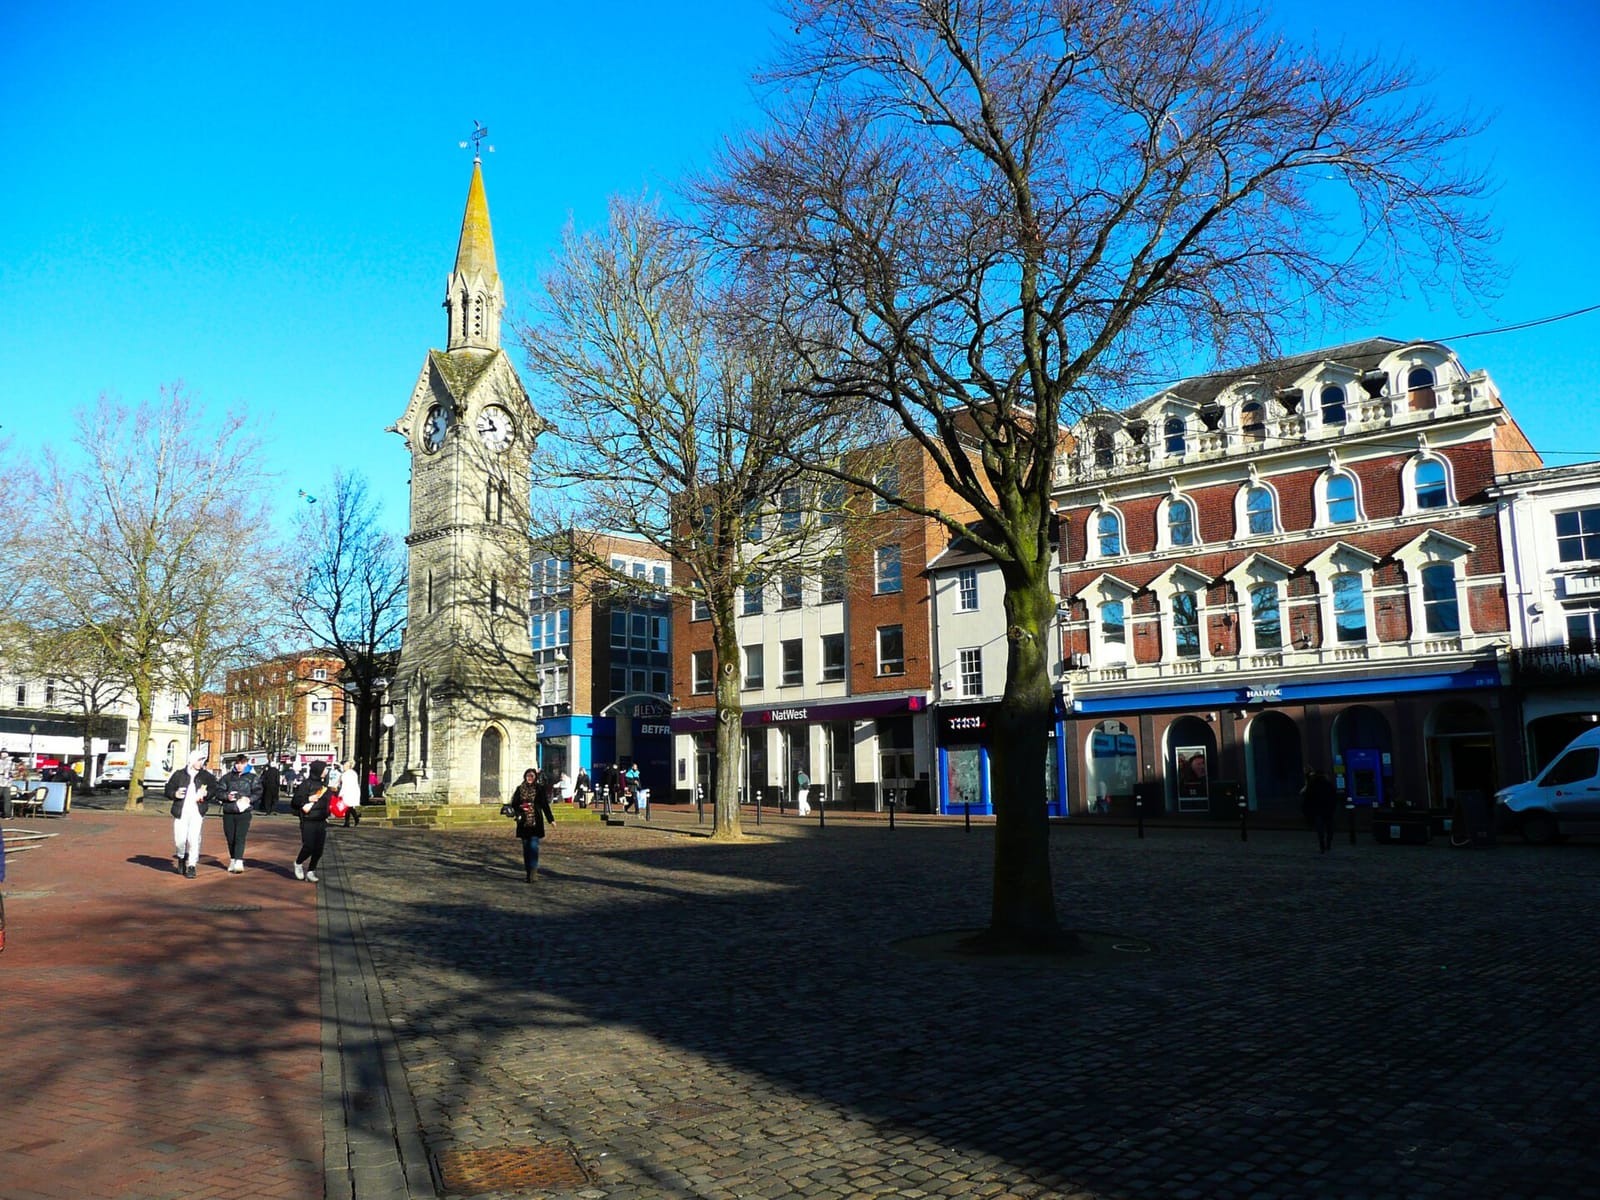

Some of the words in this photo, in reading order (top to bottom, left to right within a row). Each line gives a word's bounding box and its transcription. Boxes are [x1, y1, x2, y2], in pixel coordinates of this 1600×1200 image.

[1246, 689, 1281, 698] HALIFAX
[772, 708, 808, 721] NatWest
[641, 724, 672, 735] BETFR
